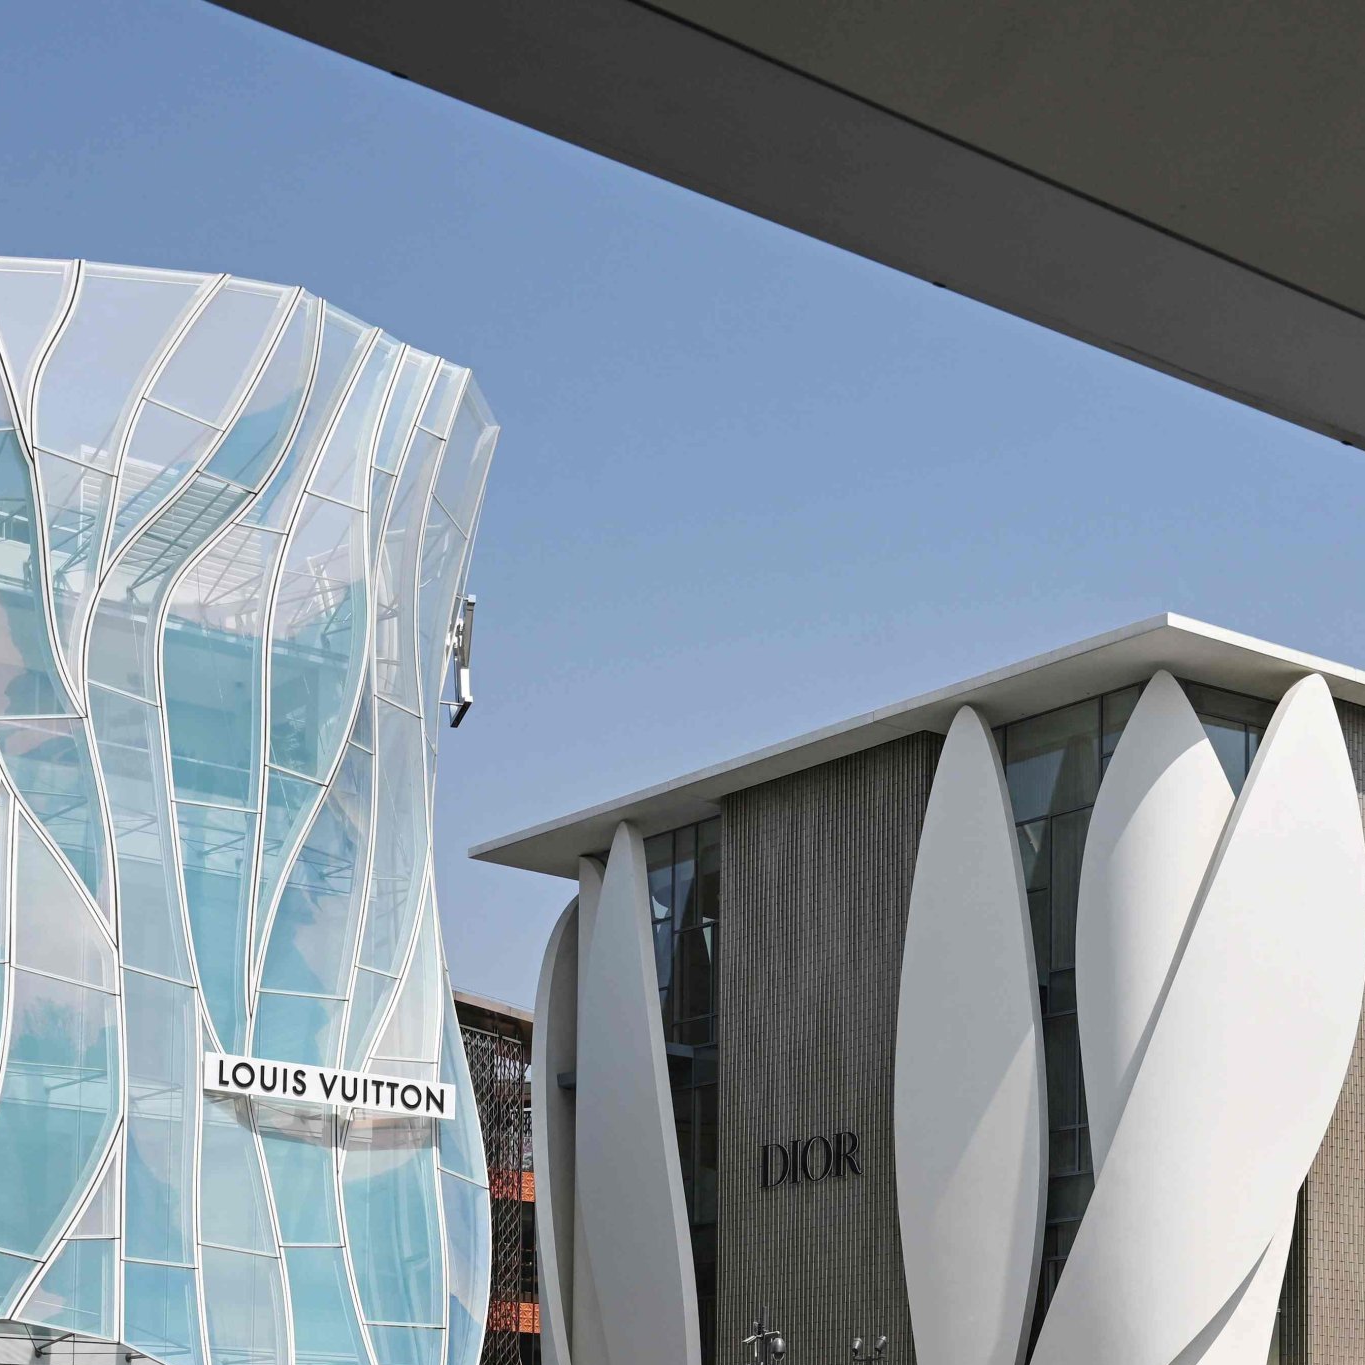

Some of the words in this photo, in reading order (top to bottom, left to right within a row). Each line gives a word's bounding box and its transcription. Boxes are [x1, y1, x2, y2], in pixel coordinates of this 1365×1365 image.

[218, 1060, 306, 1095] LOUIS
[319, 1073, 445, 1114] VUITTON
[758, 1131, 863, 1189] DIOR
